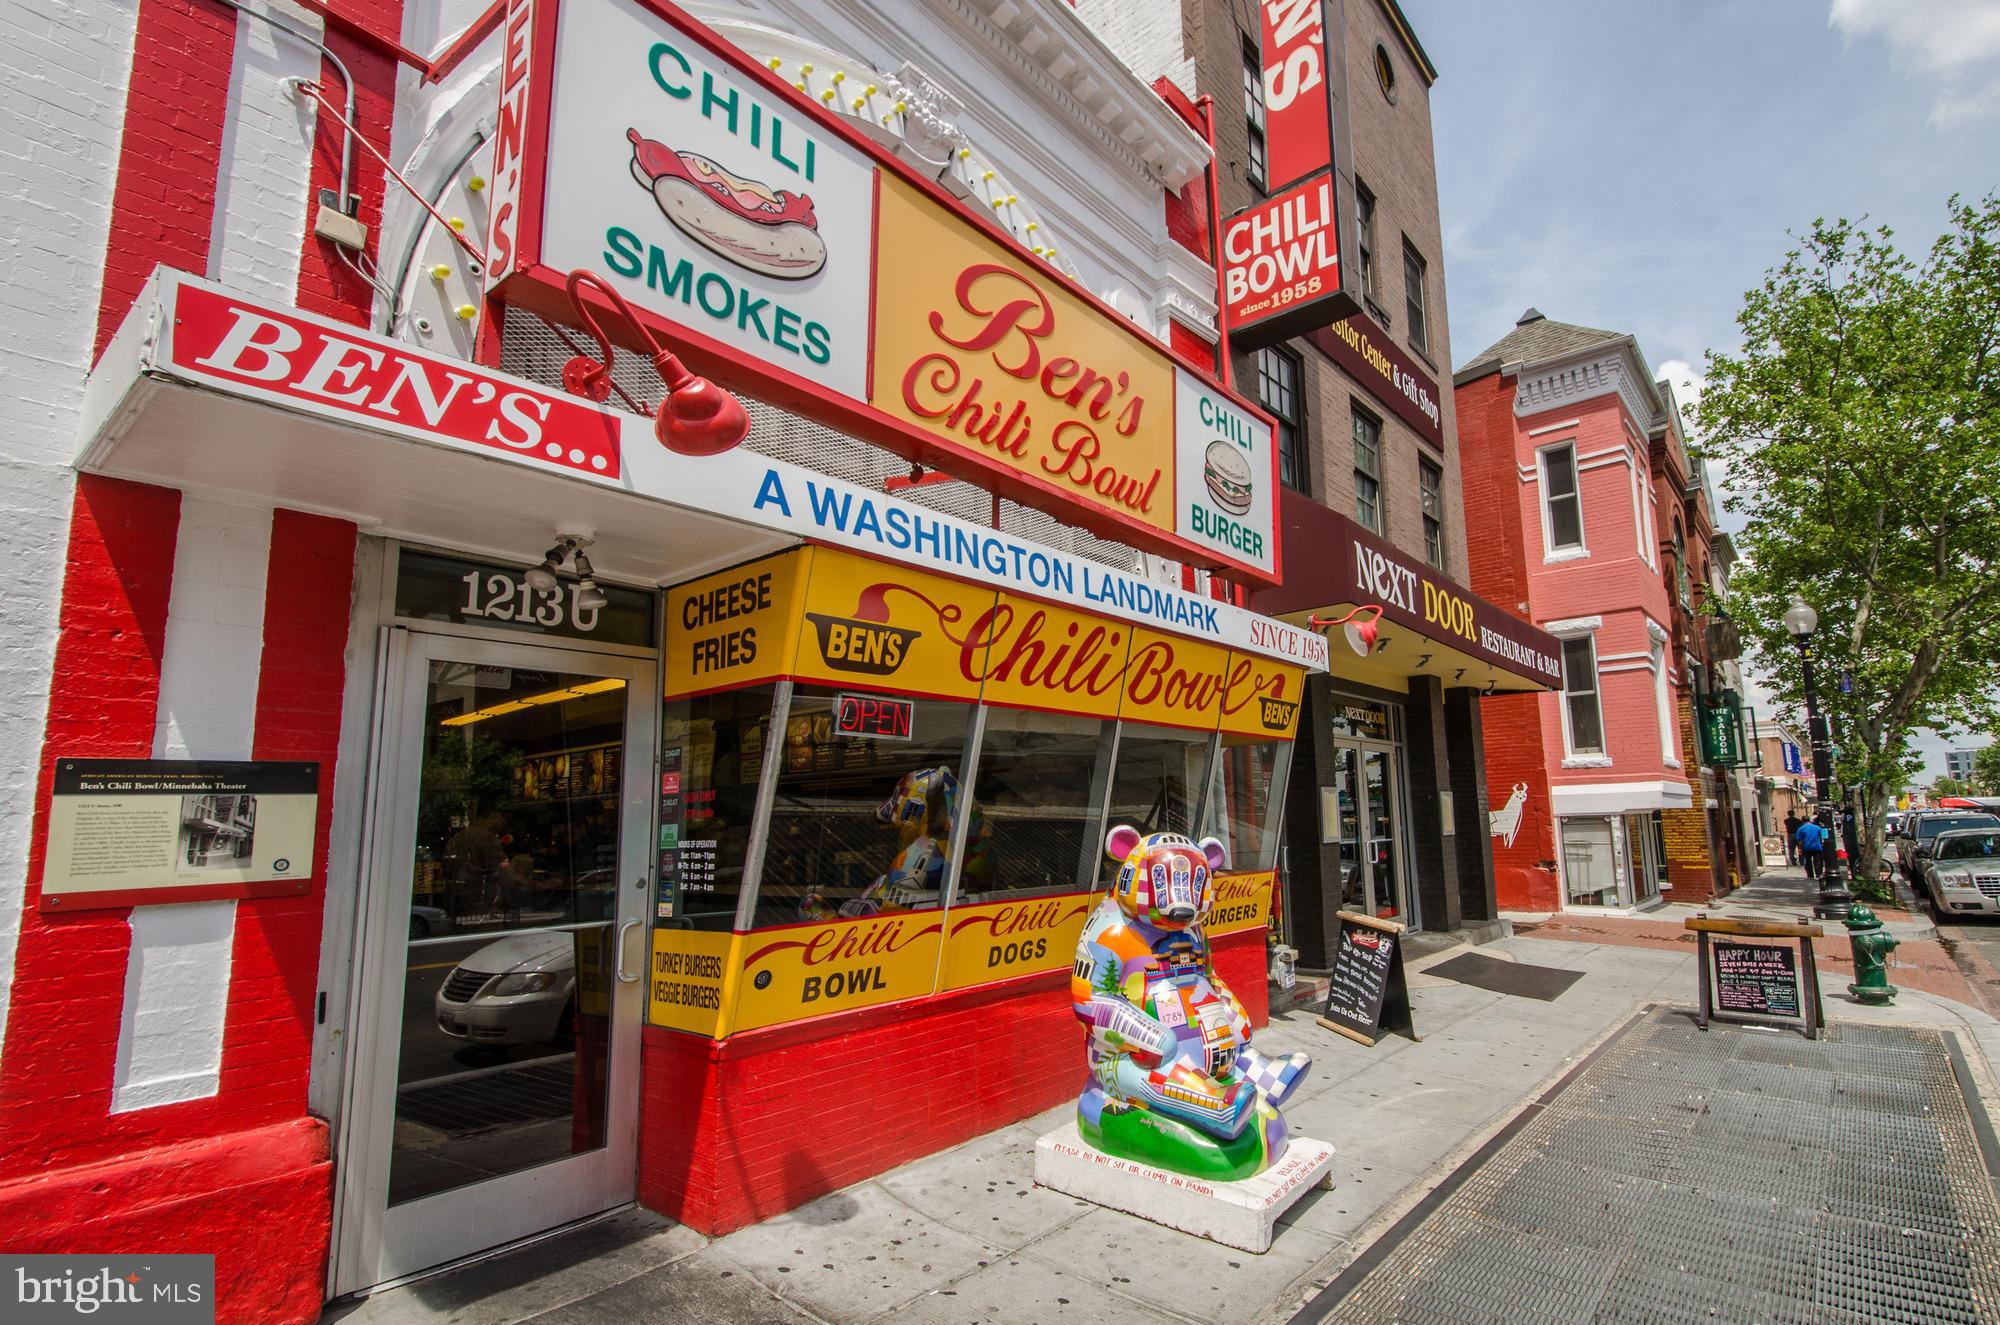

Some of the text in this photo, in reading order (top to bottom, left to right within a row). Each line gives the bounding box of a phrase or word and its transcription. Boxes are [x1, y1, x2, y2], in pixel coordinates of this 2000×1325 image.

[648, 42, 815, 183] CHILI
[489, 0, 531, 278] EN'S
[1224, 183, 1331, 264] CHILI
[1227, 230, 1338, 305] BOWL
[603, 226, 831, 365] SMOKES
[1240, 276, 1322, 317] since 1958
[928, 264, 1144, 436] Ben's
[1361, 334, 1392, 382] Center
[1392, 364, 1402, 390] &
[1402, 373, 1418, 406] Gift
[1419, 388, 1439, 428] Shop
[901, 353, 1162, 513] Chili Bowl
[1199, 397, 1253, 451] CHILI
[1191, 504, 1264, 560] BURGER
[753, 470, 1327, 665] A WASHINGTON LANDMARK SINCE 1958
[682, 573, 772, 631] CHEESE
[692, 627, 757, 675] FRIES
[827, 623, 902, 668] BEN'S
[1422, 579, 1478, 643] DOOR
[1481, 626, 1537, 670] RESTAURANT
[1537, 654, 1544, 672] &
[1544, 655, 1561, 679] BAR
[959, 603, 1256, 716] Chili Bowl
[840, 697, 911, 737] OPEN
[1264, 702, 1291, 727] BEN'S
[1717, 715, 1728, 754] SALOON
[80, 782, 105, 790] Ben's
[107, 782, 132, 790] Chili
[214, 782, 247, 790] Theater
[1215, 877, 1256, 903] Chili
[802, 919, 910, 967] Chili
[988, 901, 1064, 938] Chili
[655, 952, 721, 980] TURKEY BURGERS
[988, 937, 1047, 968] DOGS
[1718, 949, 1782, 962] HAPPY HOUR
[654, 984, 720, 1010] VEGGIE BURGERS
[802, 965, 887, 1003] BOWL
[1163, 1011, 1182, 1024] 1789
[1054, 1143, 1214, 1197] PLEASE DO NOT SIT OR CLIMB ON PANDA
